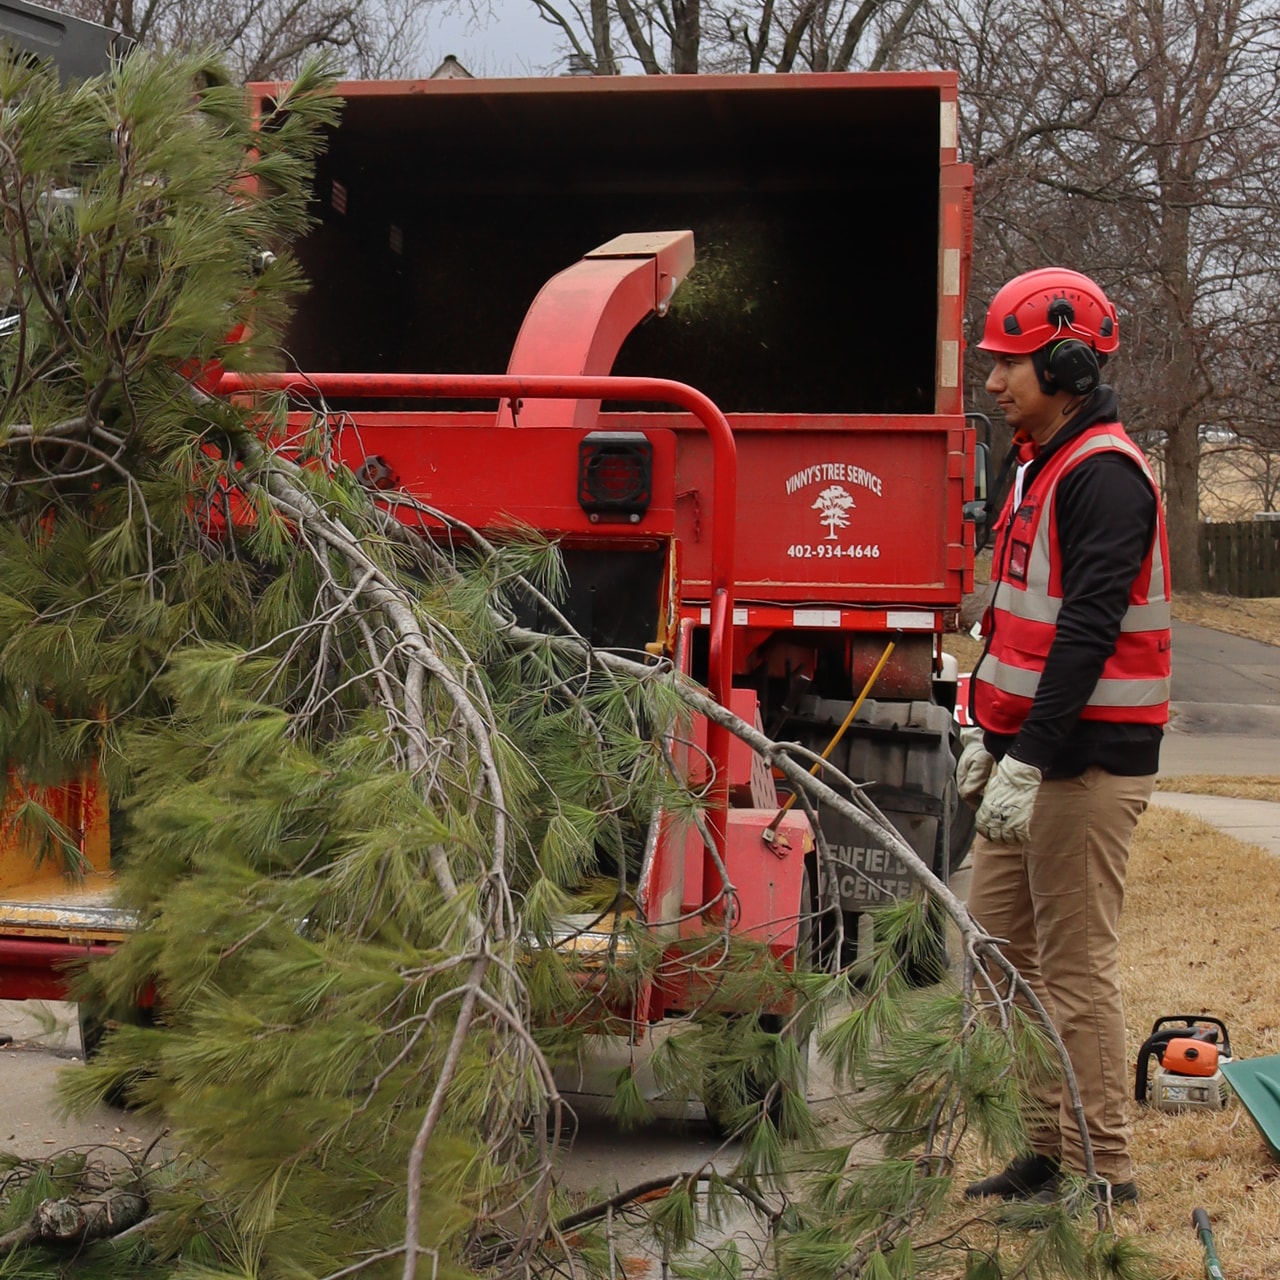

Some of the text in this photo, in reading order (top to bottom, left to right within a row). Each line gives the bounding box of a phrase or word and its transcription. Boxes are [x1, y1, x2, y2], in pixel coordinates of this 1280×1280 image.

[786, 463, 883, 497] VINNY'S TREE SERVICE
[787, 544, 880, 558] 402-934-4646
